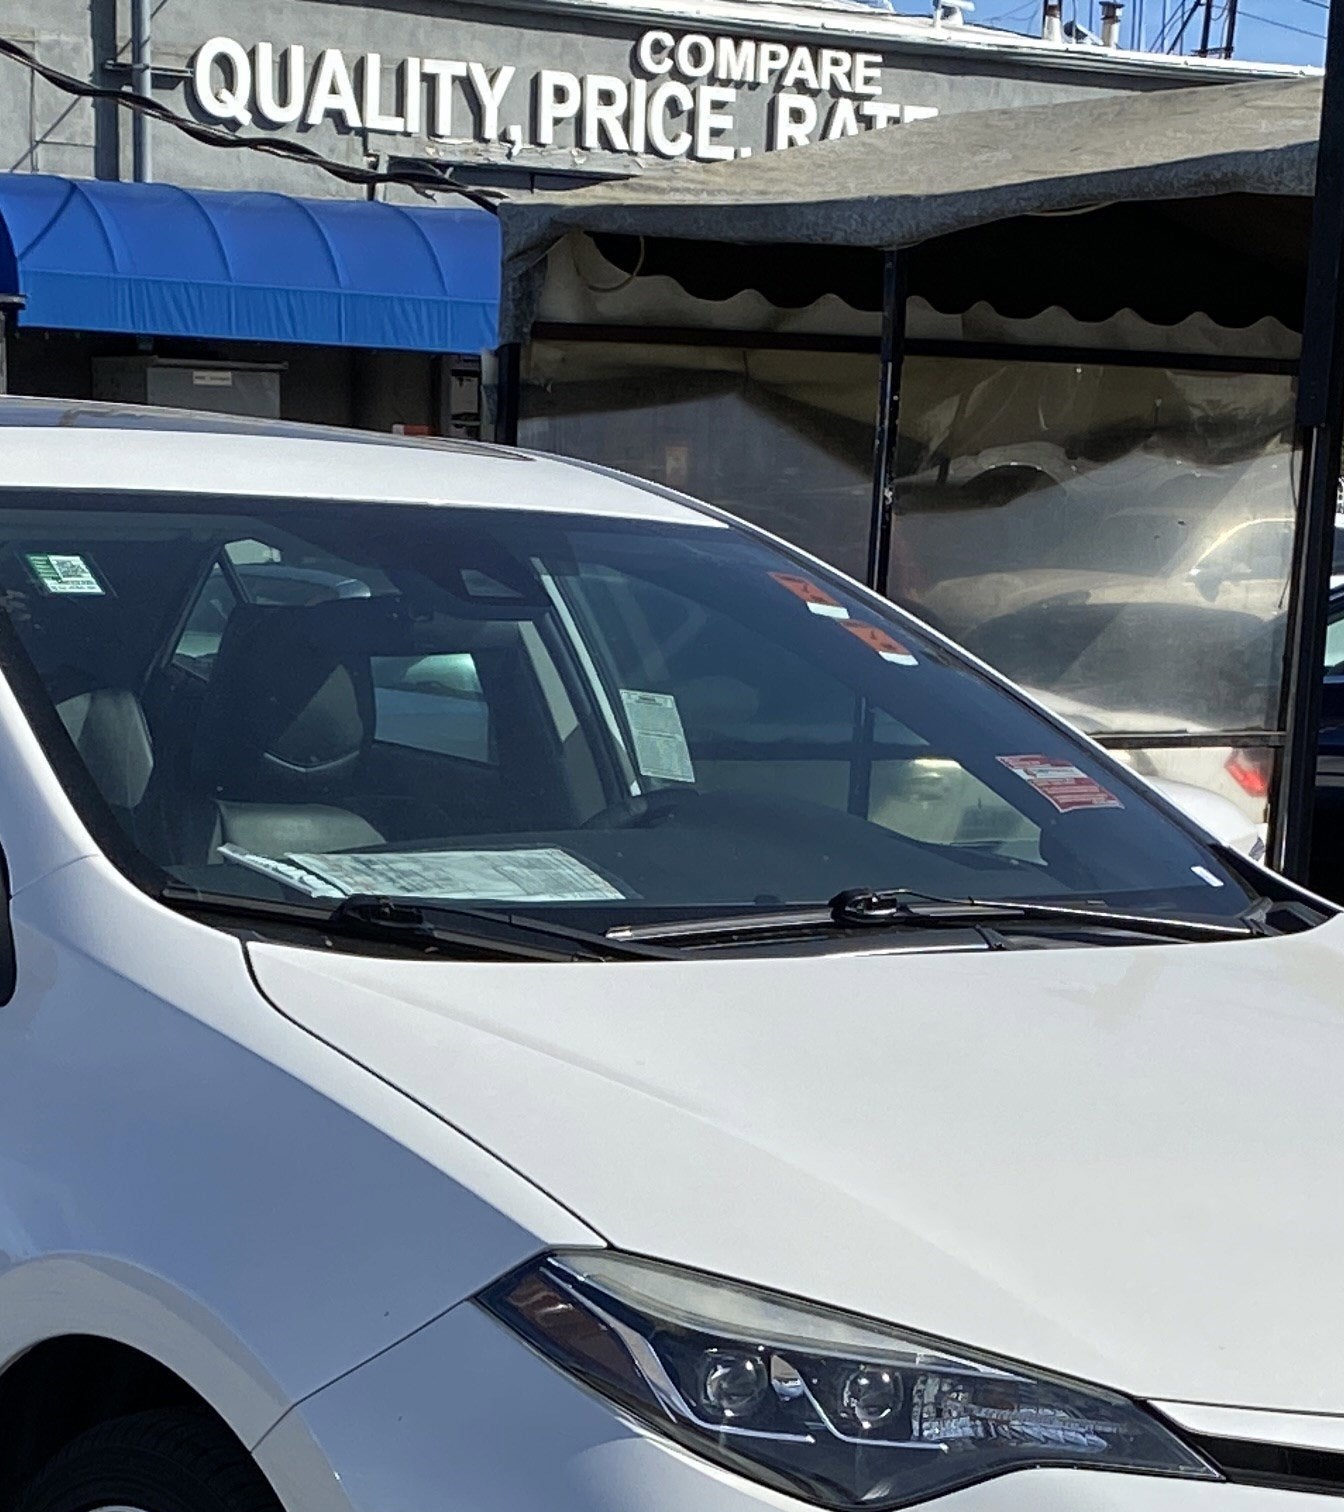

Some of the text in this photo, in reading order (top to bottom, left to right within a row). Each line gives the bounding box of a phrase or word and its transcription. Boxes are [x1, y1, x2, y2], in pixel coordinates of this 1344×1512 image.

[194, 36, 516, 157] QUALITY,
[776, 92, 940, 151] RAT
[640, 30, 883, 95] COMPARE
